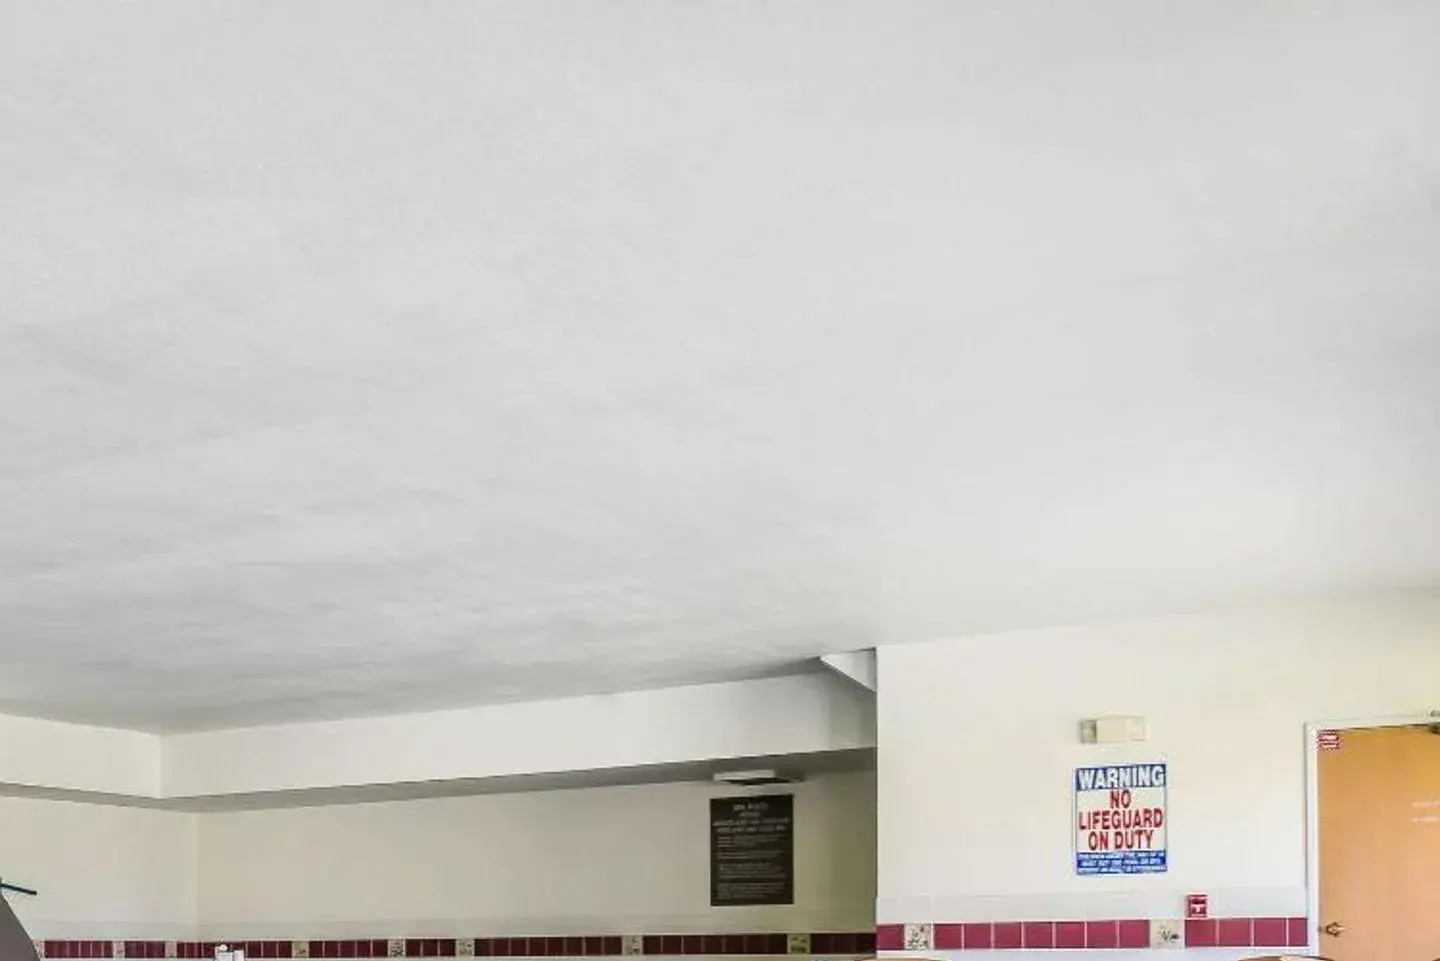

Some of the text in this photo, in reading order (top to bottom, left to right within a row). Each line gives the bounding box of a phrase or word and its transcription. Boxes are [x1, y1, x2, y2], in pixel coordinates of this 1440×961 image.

[1079, 765, 1165, 790] WARNING
[1109, 789, 1132, 809] NO
[1078, 808, 1164, 830] LIFEGUARD
[1088, 829, 1154, 850] ON DUTY
